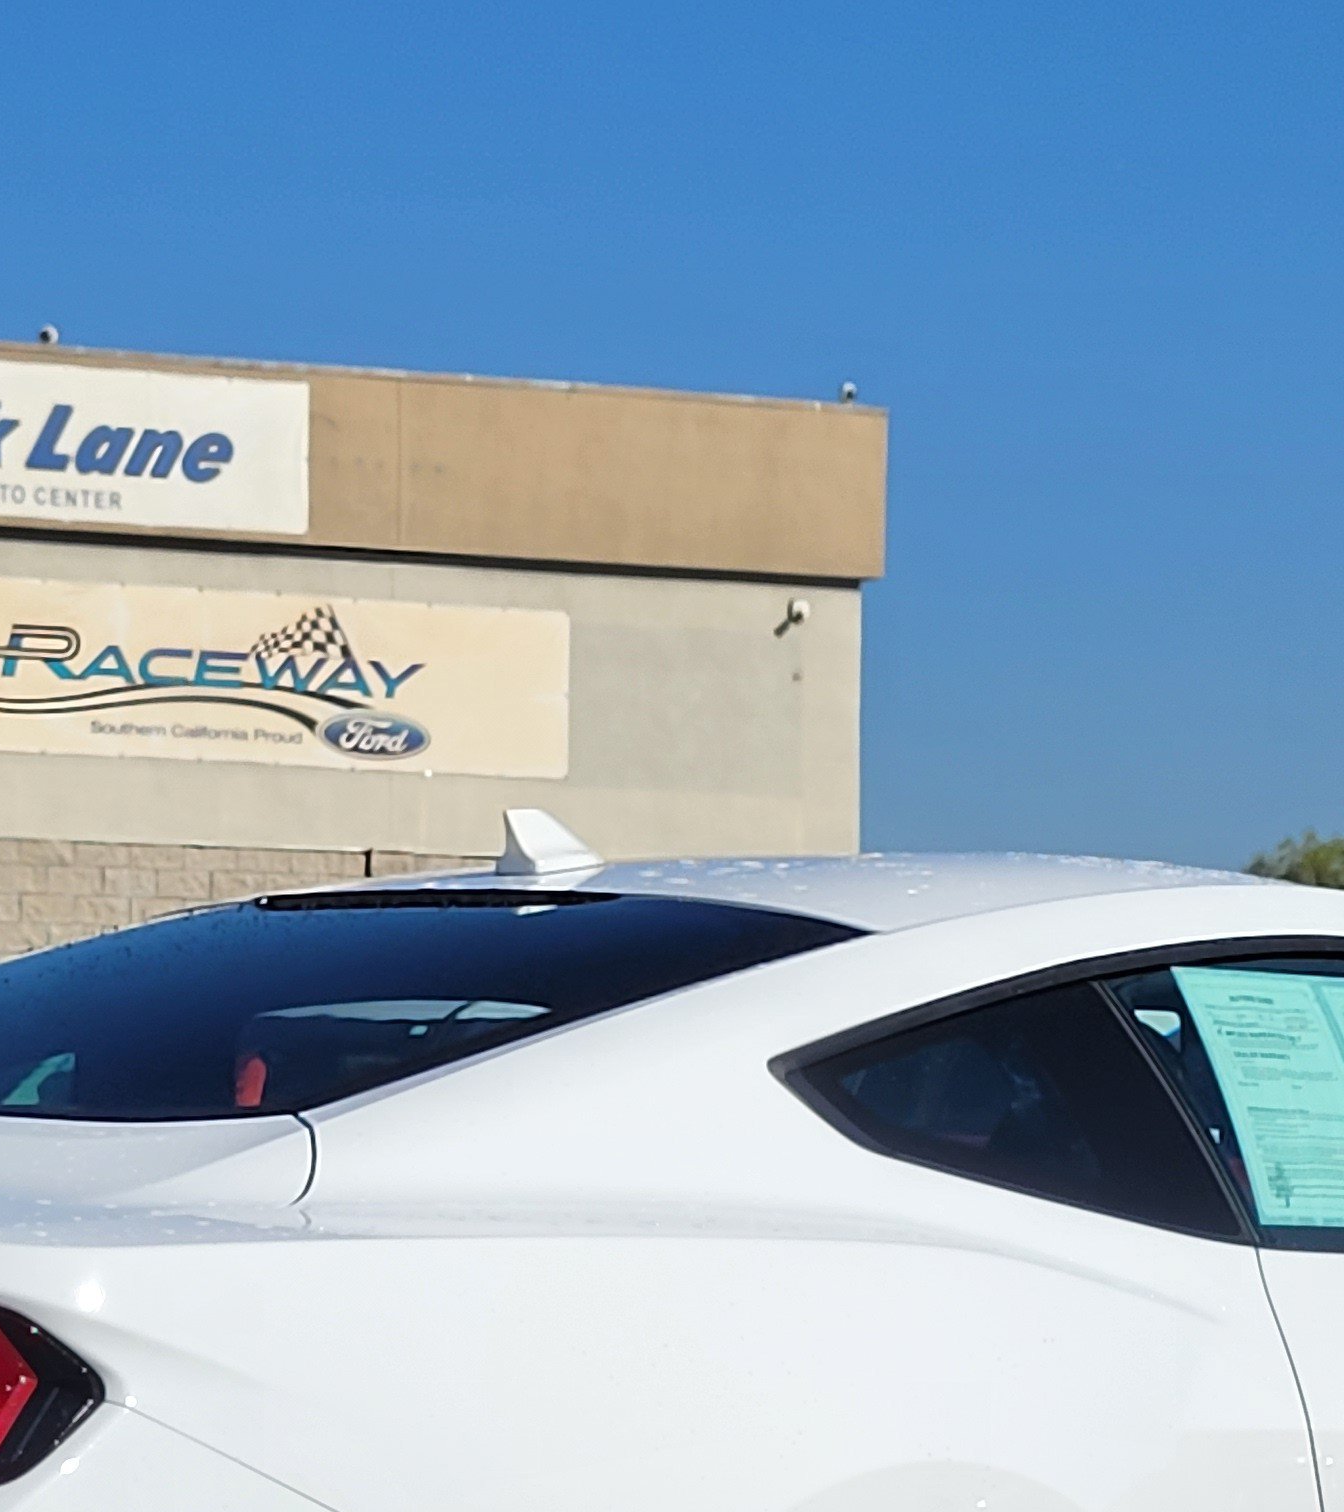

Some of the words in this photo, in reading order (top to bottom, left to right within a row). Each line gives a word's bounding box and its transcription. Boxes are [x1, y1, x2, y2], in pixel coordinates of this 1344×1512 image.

[25, 404, 234, 483] Lane
[32, 486, 123, 510] CENTER
[1, 624, 427, 699] RACEWAY
[90, 720, 166, 738] Southern
[170, 726, 248, 743] California
[254, 729, 304, 746] Proud
[338, 718, 410, 754] Ford
